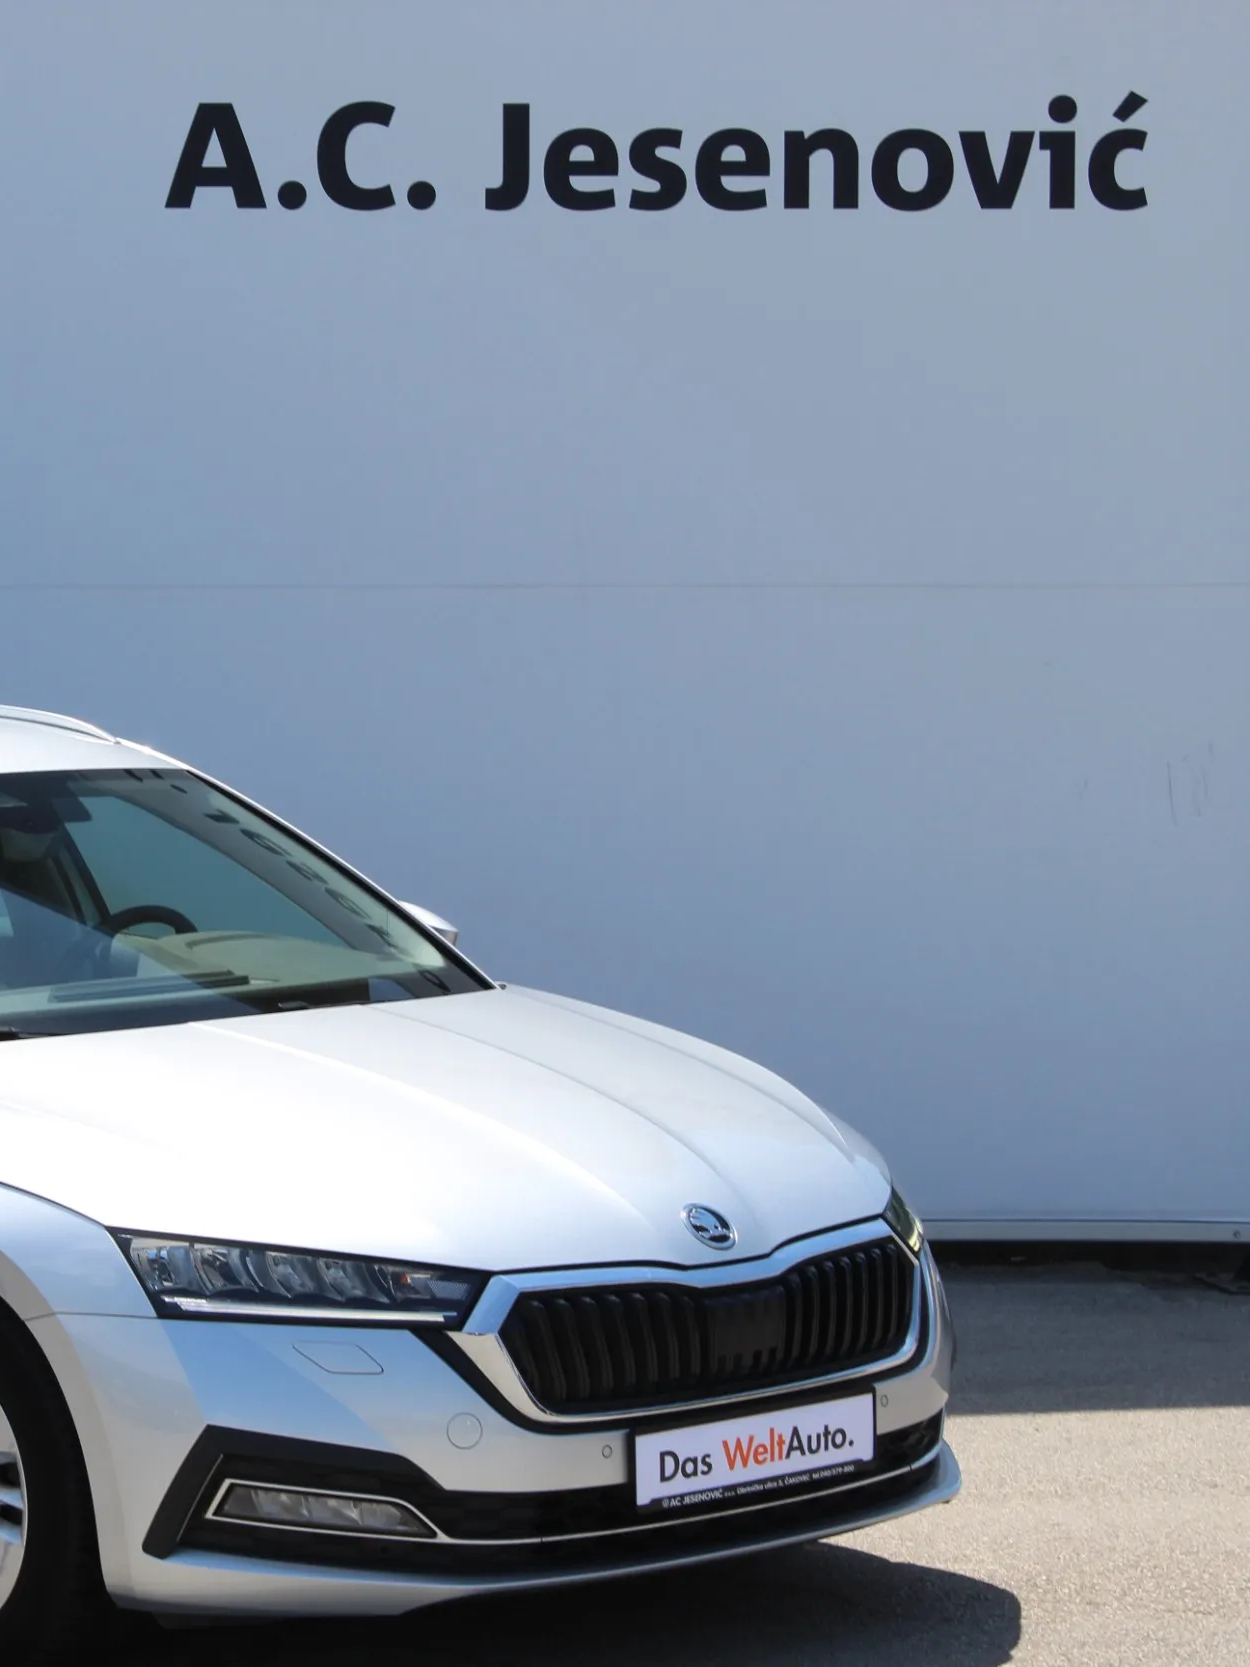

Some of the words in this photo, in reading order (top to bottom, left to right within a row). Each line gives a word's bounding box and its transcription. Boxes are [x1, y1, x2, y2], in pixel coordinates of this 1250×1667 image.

[165, 101, 436, 211] A.C.
[485, 91, 1148, 212] Jesenović
[659, 1450, 713, 1483] Das
[722, 1424, 854, 1471] WeltAuto.
